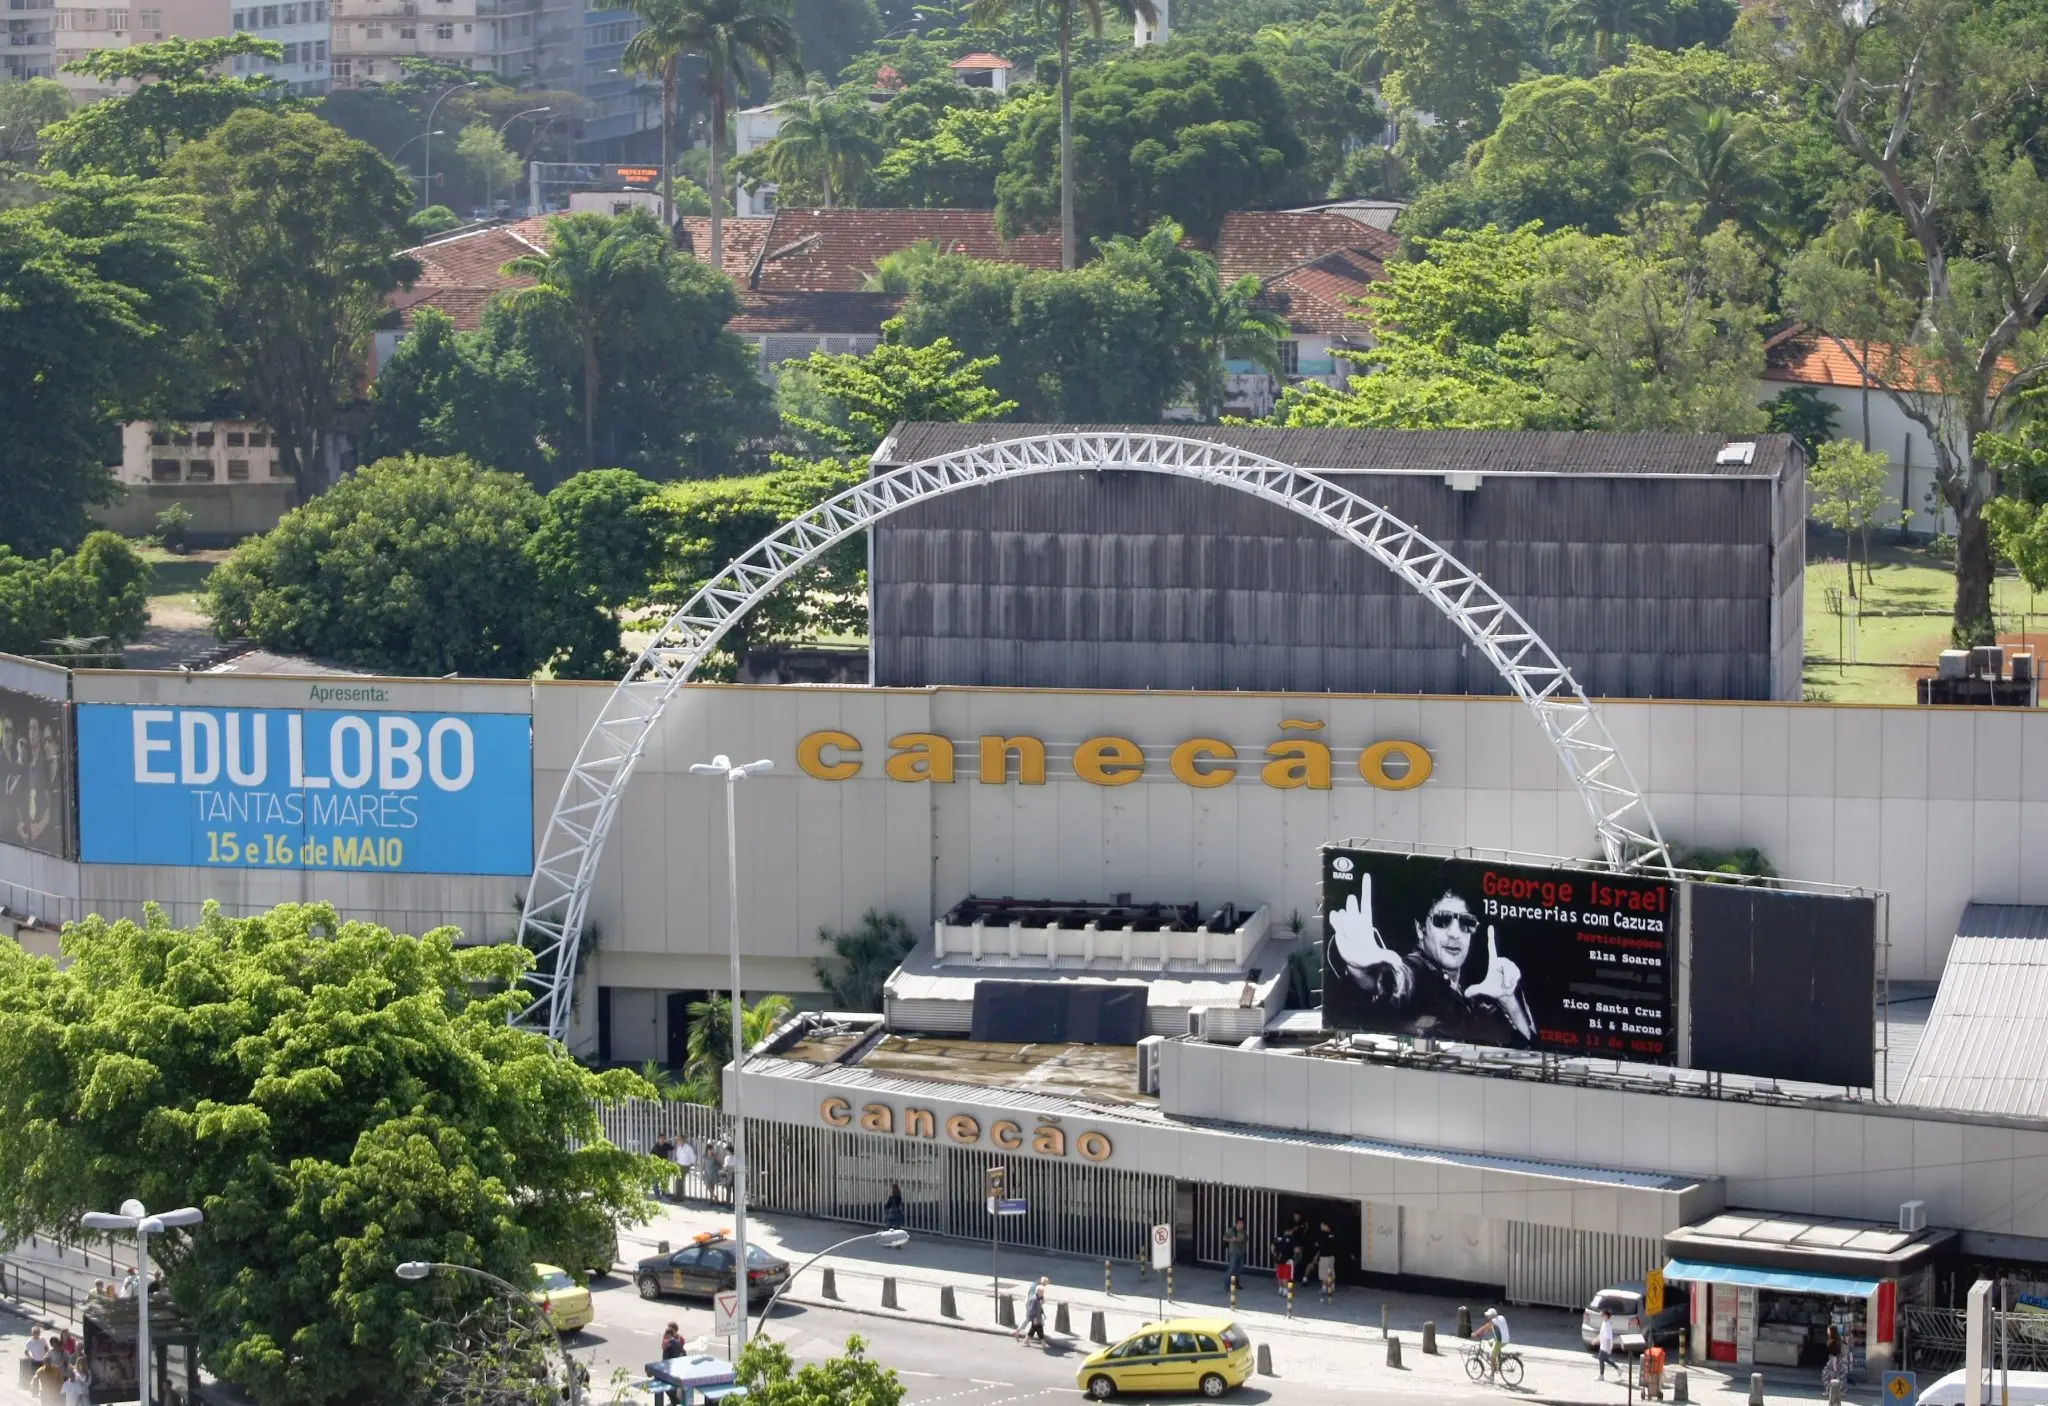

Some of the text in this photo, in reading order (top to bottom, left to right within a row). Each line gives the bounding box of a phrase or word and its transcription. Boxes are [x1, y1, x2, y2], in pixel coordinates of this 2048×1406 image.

[310, 684, 388, 703] Apresenta:
[133, 709, 474, 792] EDU LOBO
[797, 719, 1433, 791] canecão
[190, 790, 418, 829] TANTAS MARÉS
[207, 831, 403, 868] 15 e 16 de MAIO
[1332, 871, 1354, 880] BAND
[1483, 871, 1666, 912] George Israel
[1483, 899, 1664, 932] 13 parcerias com Cazuza
[1589, 950, 1661, 966] Elza Soares
[1563, 999, 1661, 1018] Tico Santa Cruz
[1589, 1019, 1662, 1035] Bi & Barone
[820, 1096, 1113, 1162] canecão
